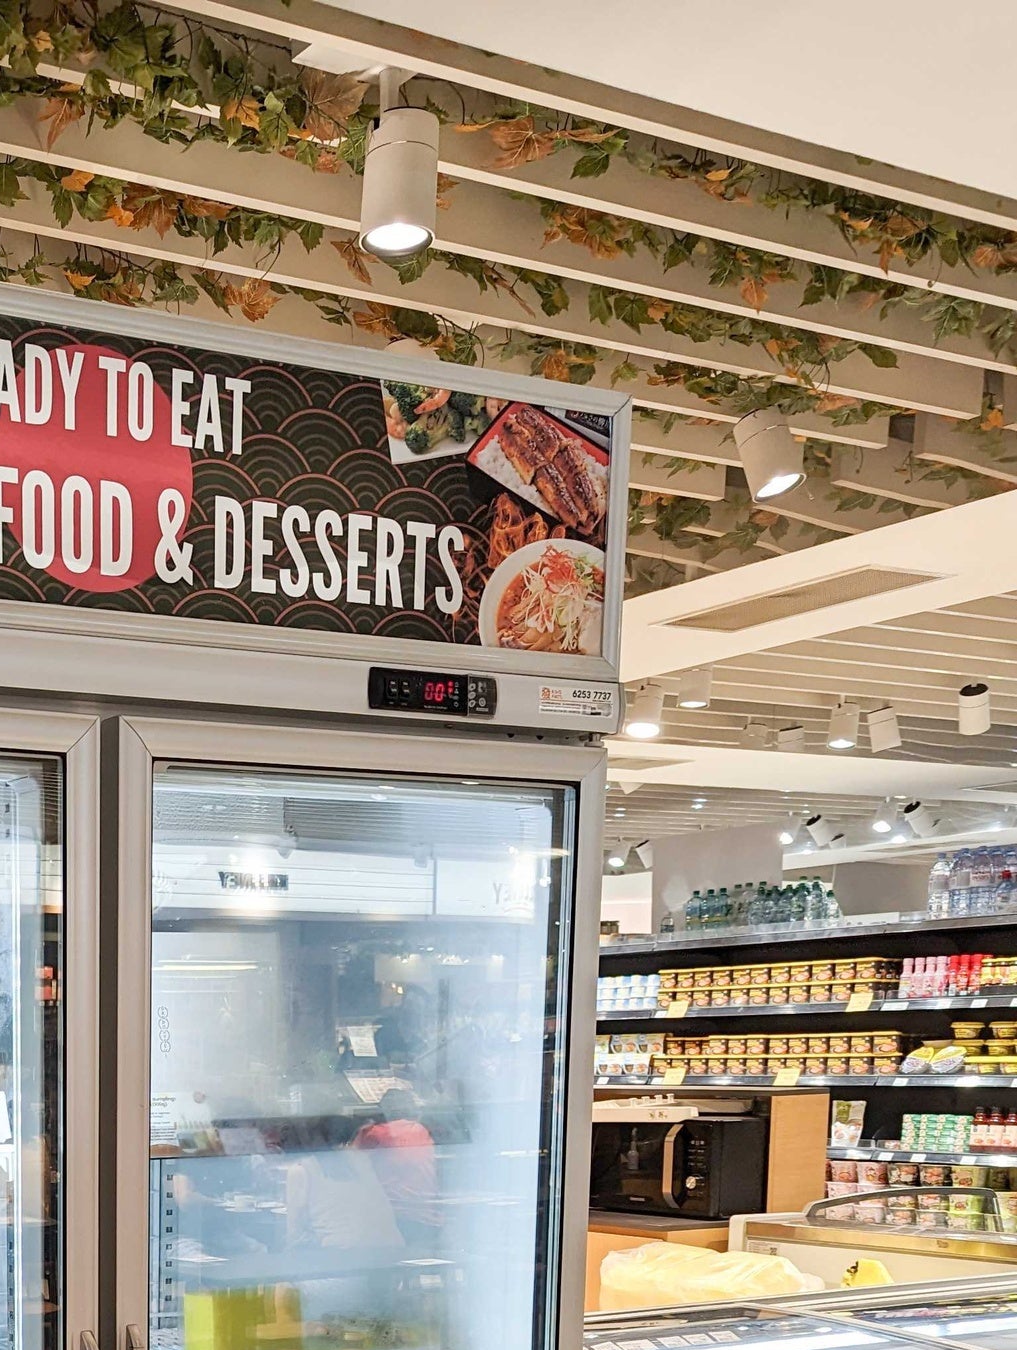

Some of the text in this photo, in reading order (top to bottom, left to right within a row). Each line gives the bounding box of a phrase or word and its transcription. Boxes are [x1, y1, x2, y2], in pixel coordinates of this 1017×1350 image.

[98, 356, 154, 441] TO
[171, 368, 252, 455] EAT
[154, 488, 194, 586] &
[214, 495, 465, 614] DESSERTS
[572, 689, 591, 699] 6253
[593, 690, 612, 701] 7737
